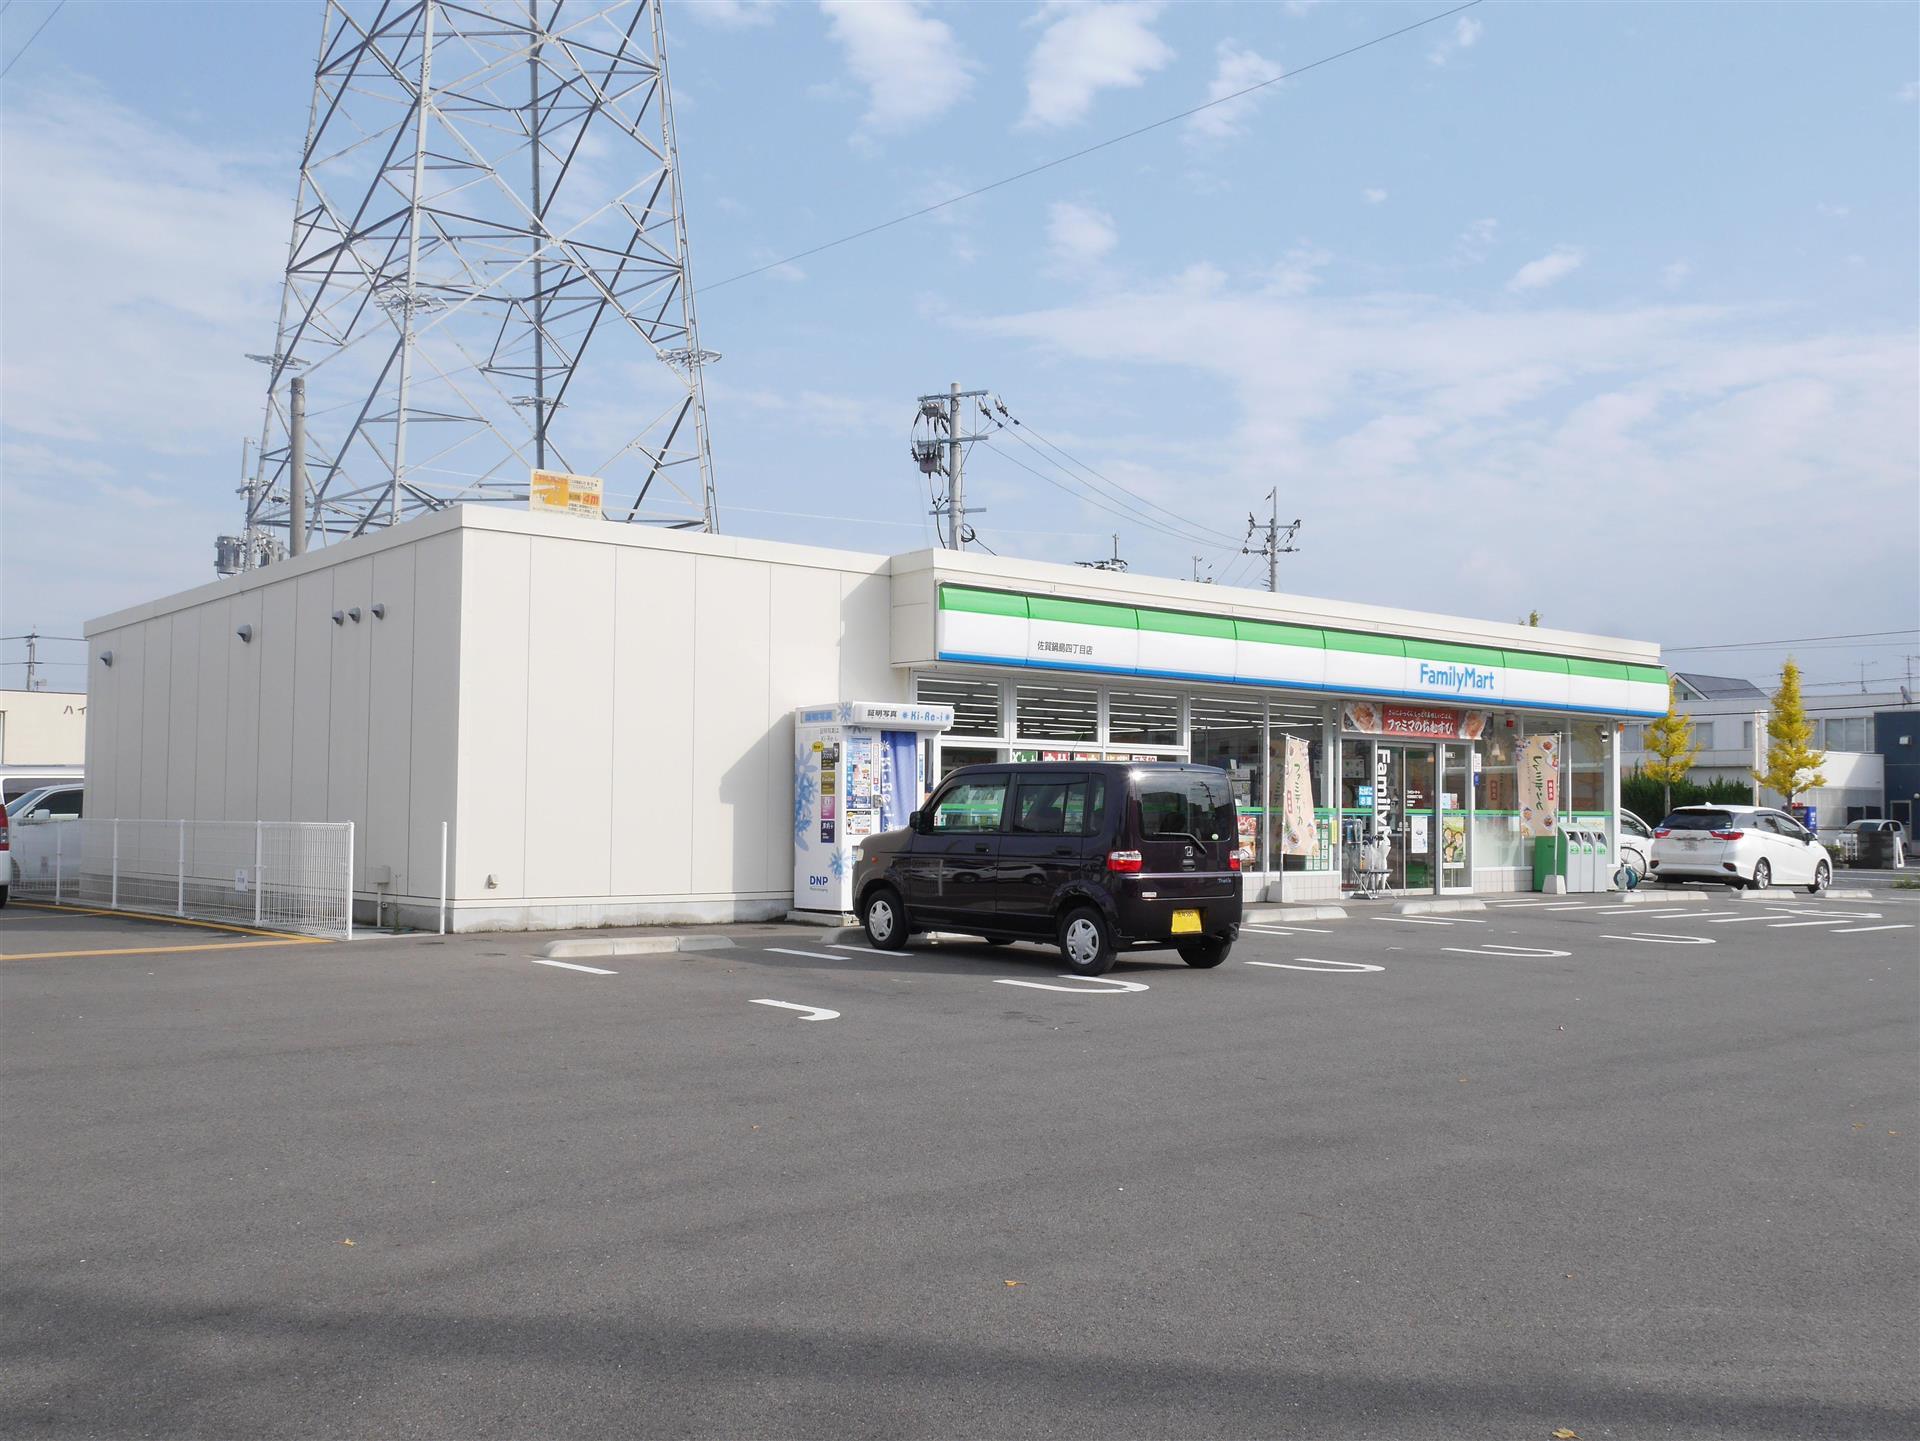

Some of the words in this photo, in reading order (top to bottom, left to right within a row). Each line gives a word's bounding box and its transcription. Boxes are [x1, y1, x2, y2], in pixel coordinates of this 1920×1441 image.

[1037, 641, 1093, 655] 佐賀鍋島四丁目店
[1420, 663, 1495, 693] FamilyMart
[867, 709, 897, 718] 証明写真
[1388, 719, 1453, 735] ファミマのおむすび
[809, 875, 829, 886] DNP
